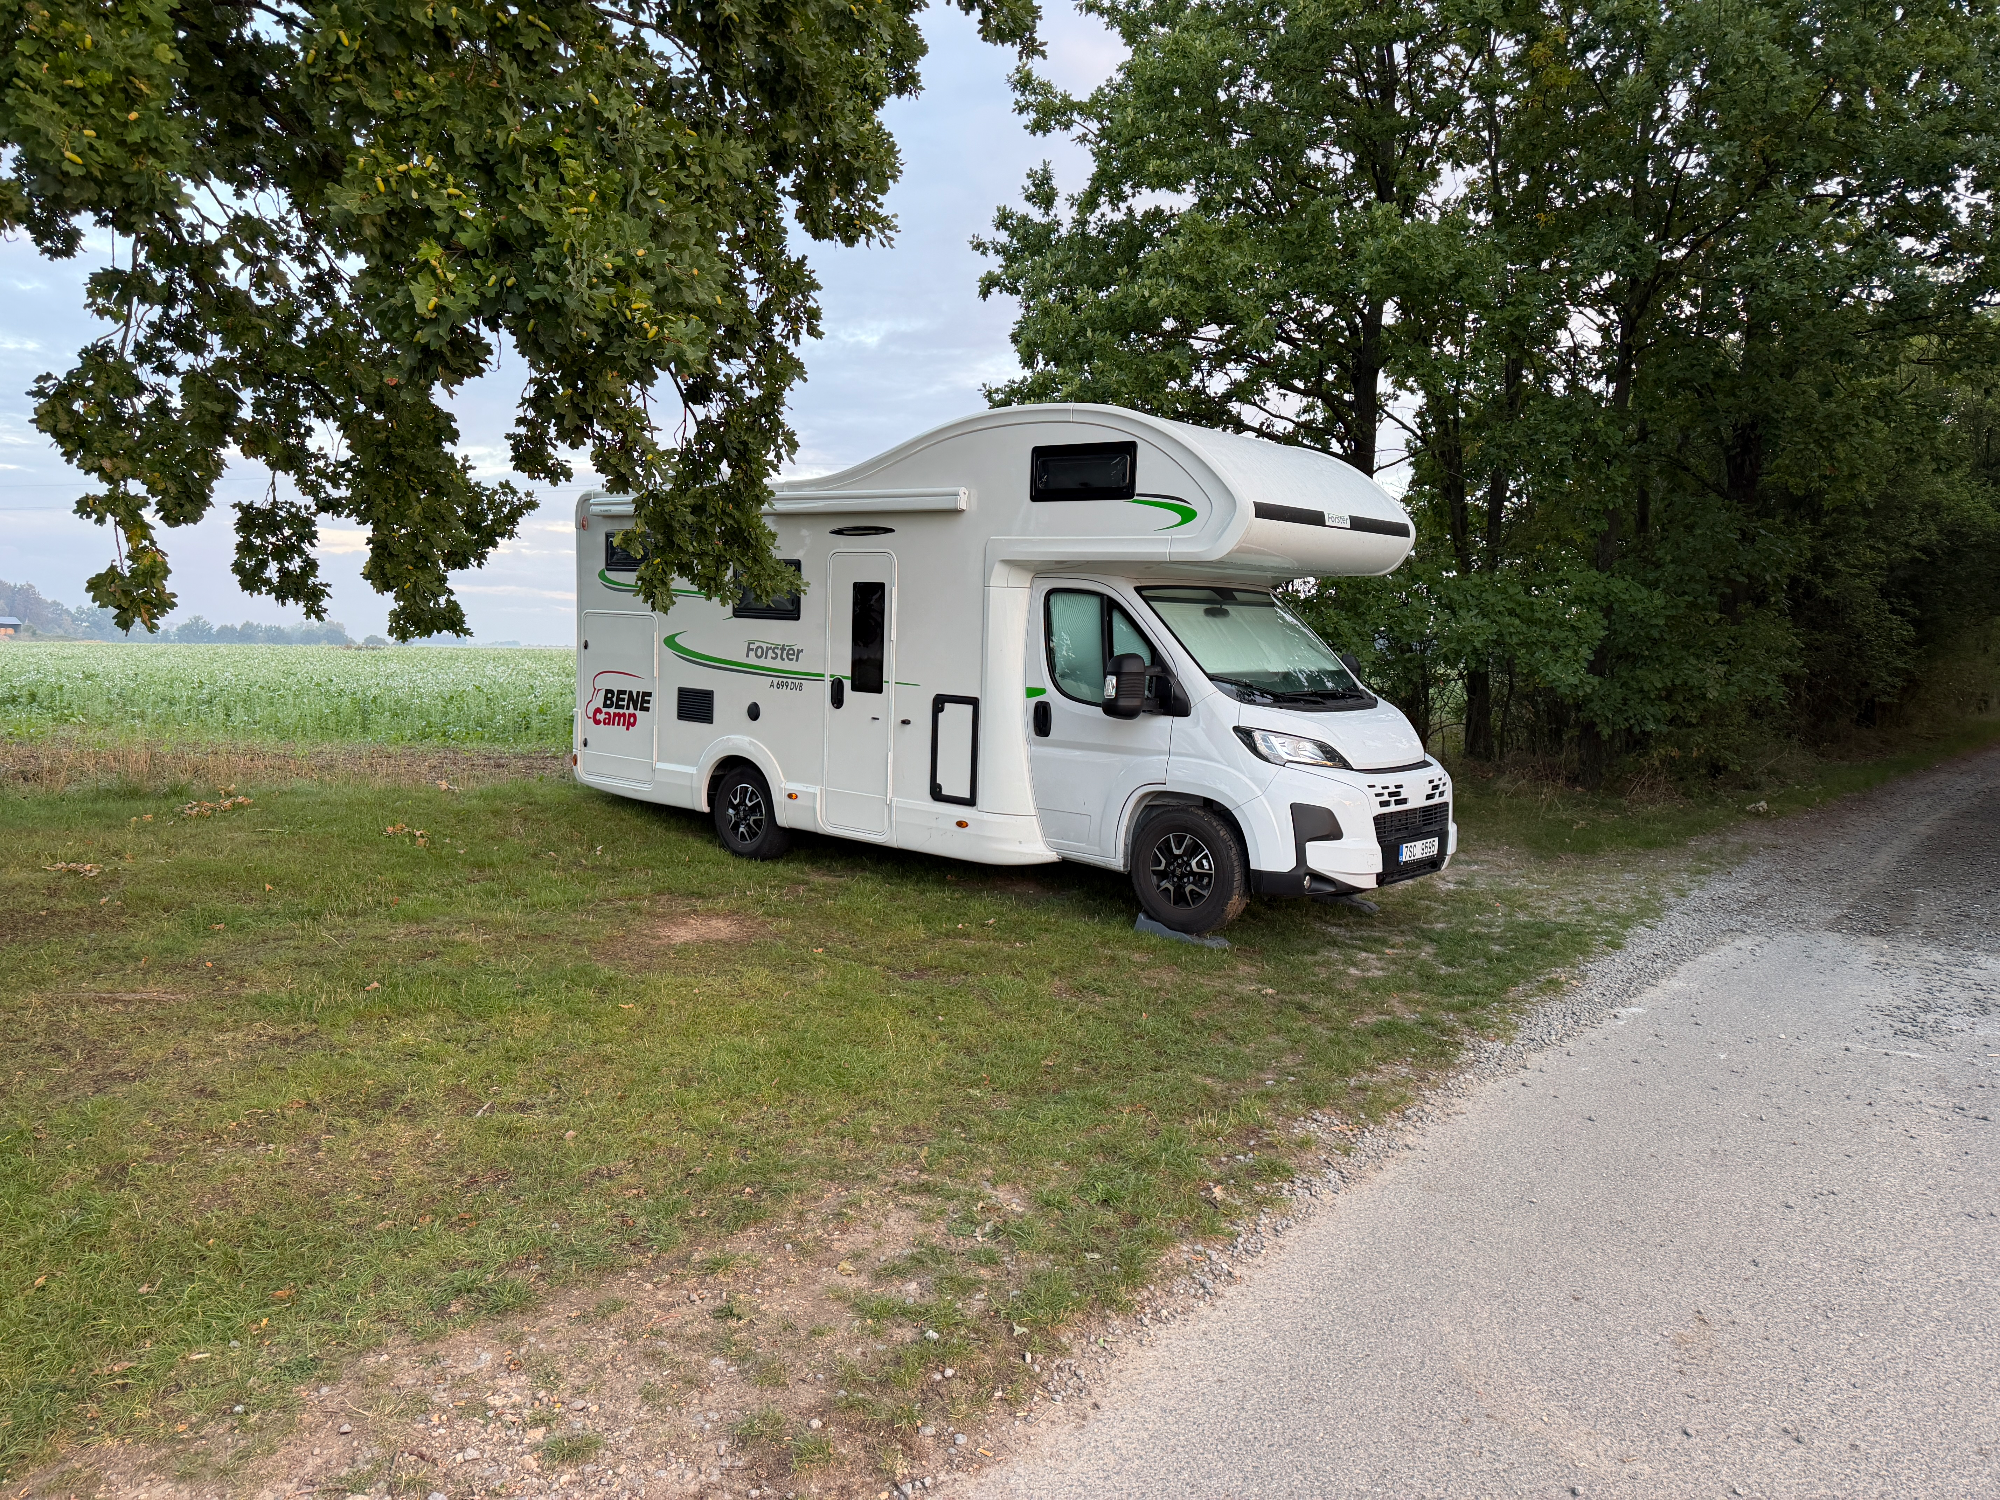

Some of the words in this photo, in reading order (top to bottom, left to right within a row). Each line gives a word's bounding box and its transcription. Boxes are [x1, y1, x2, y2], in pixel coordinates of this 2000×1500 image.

[1327, 513, 1348, 524] Forster
[745, 641, 804, 662] Forster
[769, 680, 775, 689] A
[776, 680, 789, 690] 699
[790, 681, 803, 691] DVB
[602, 688, 653, 712] BENE
[592, 707, 638, 731] Camp
[1404, 844, 1417, 860] 7SC
